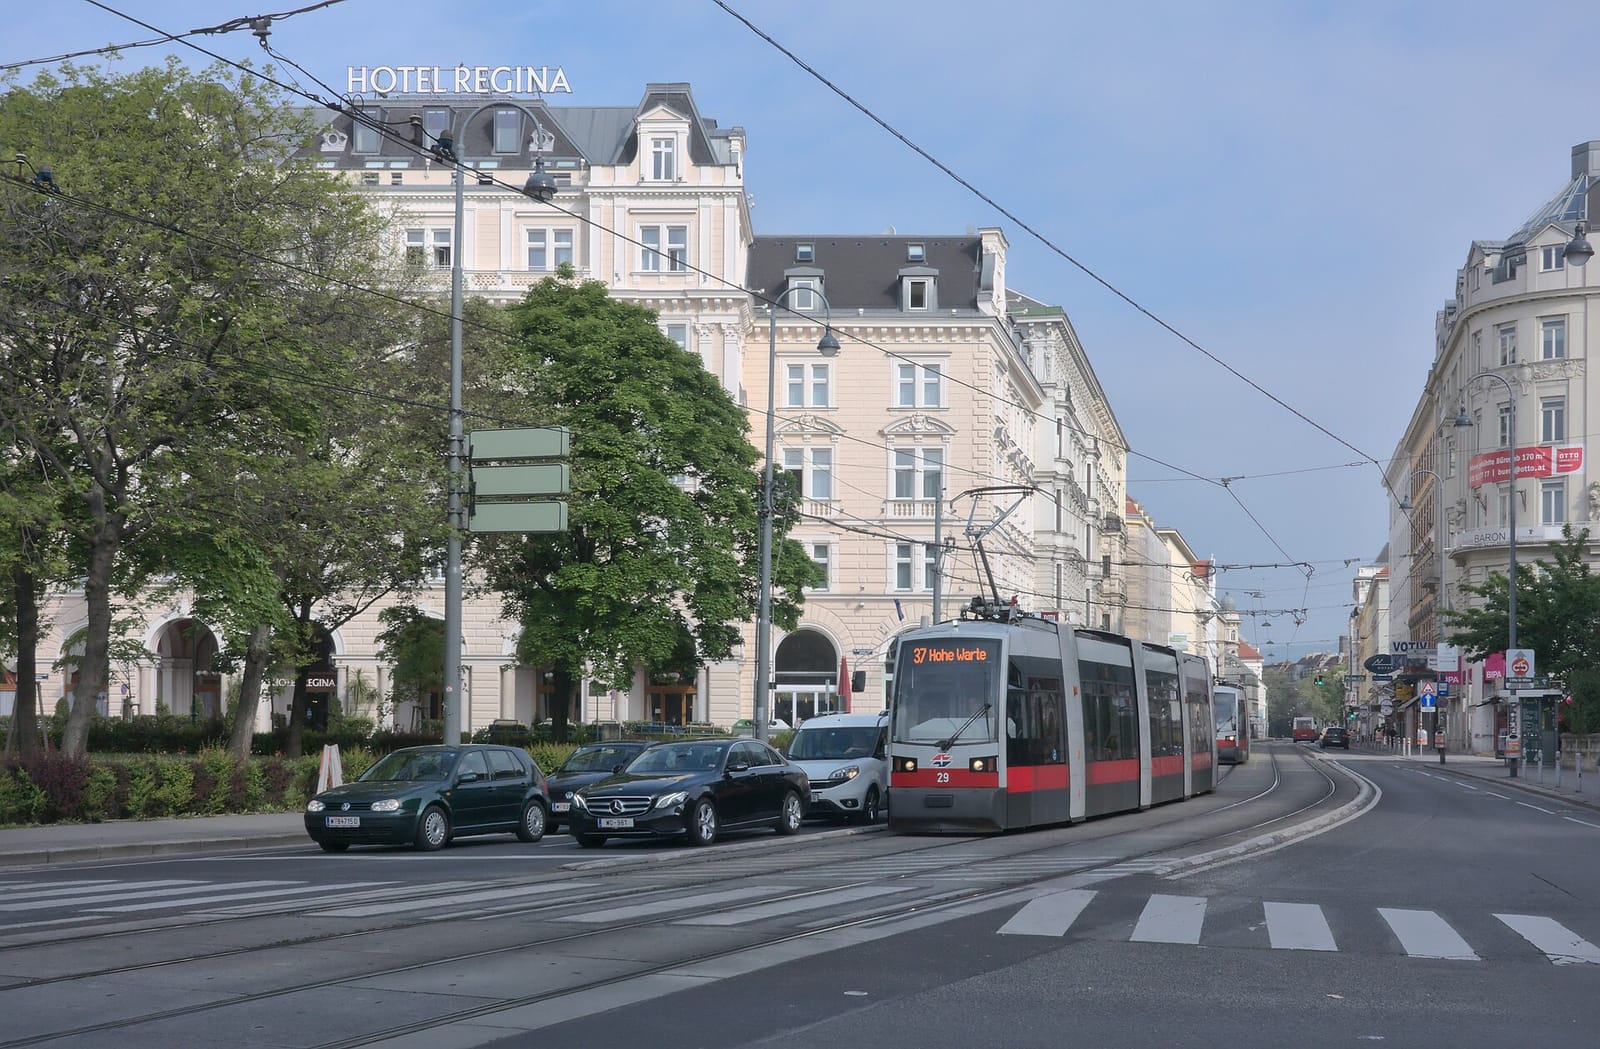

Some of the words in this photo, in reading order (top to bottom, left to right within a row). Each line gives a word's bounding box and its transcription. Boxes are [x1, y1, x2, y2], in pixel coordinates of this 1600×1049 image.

[347, 66, 448, 93] HOTEL
[454, 65, 573, 93] REGINA
[1522, 453, 1534, 461] 170
[1474, 532, 1506, 543] BARON
[1393, 641, 1428, 652] VOTIV
[913, 647, 927, 664] 37
[928, 648, 955, 662] Hohe
[956, 647, 987, 661] Warte
[1445, 676, 1459, 684] IPA
[1486, 670, 1502, 679] BIPA
[937, 772, 949, 783] 29
